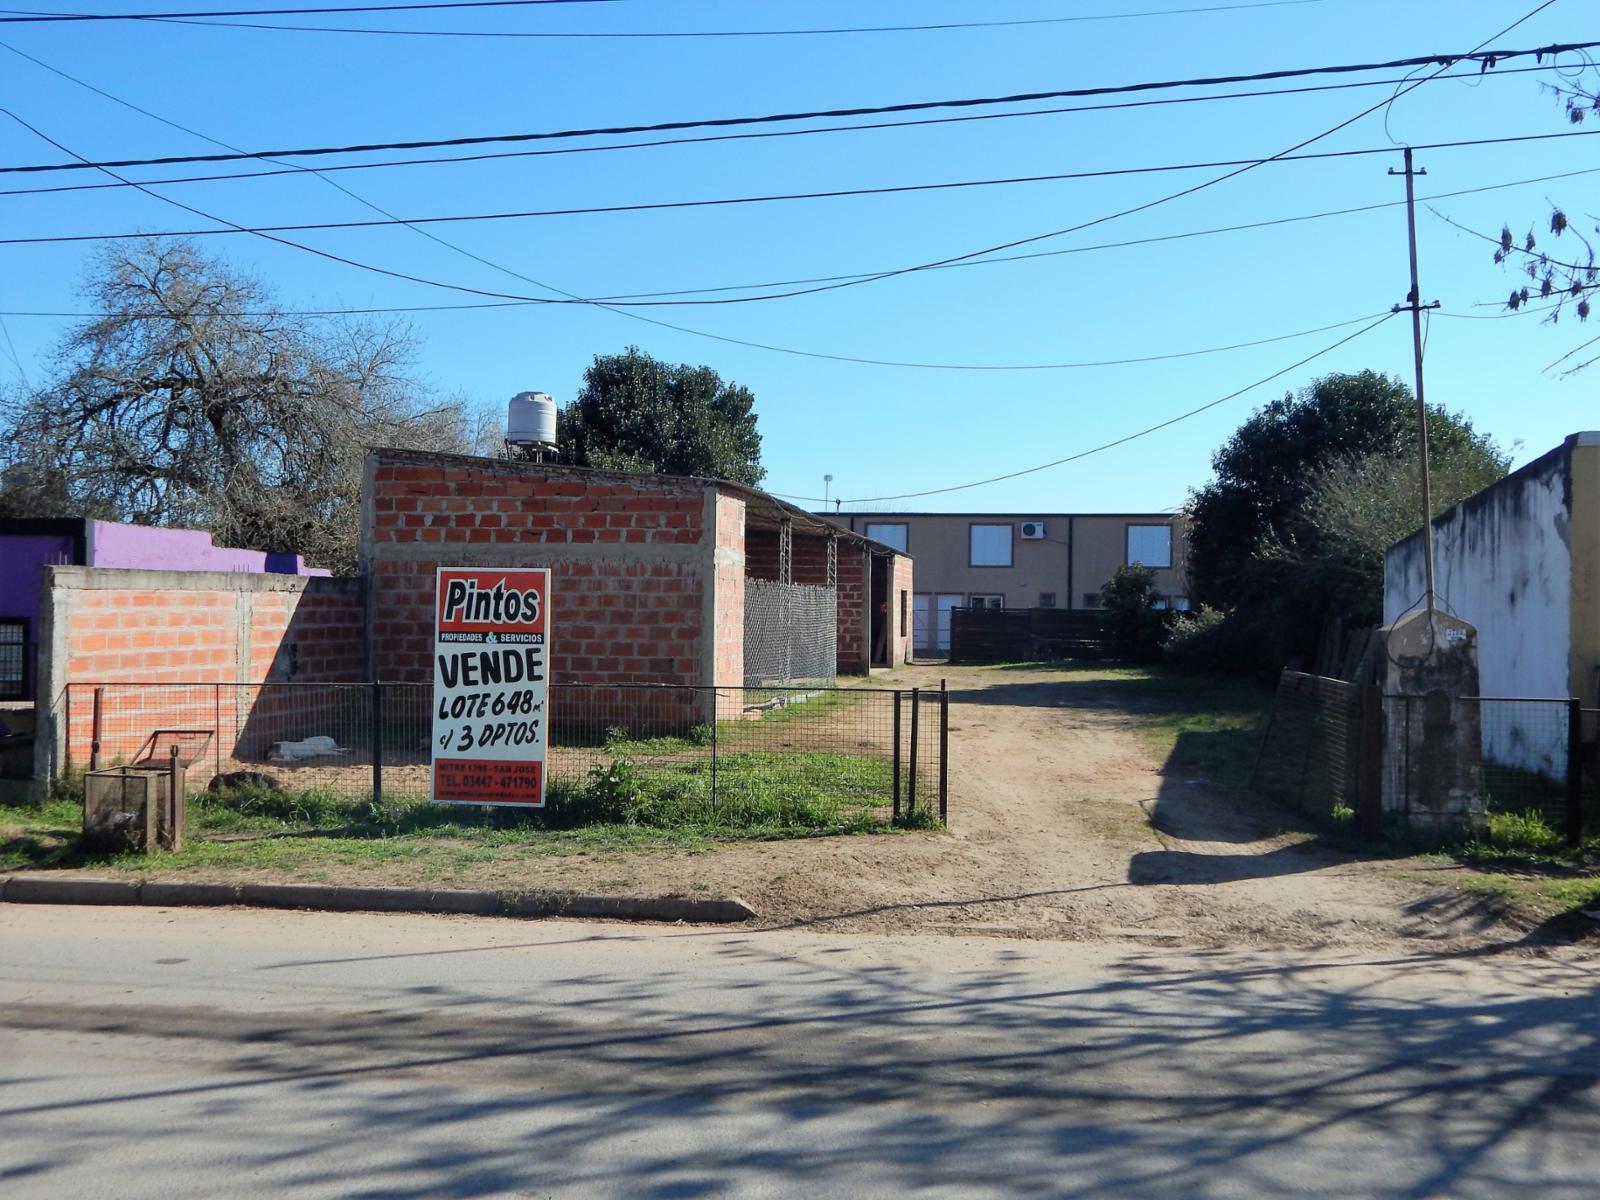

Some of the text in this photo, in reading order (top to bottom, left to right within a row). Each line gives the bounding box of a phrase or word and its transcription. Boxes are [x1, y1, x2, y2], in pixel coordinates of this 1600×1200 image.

[443, 577, 541, 624] Pintos
[441, 632, 542, 644] PROPIEDADES & SERVICIOS
[438, 648, 543, 688] VENDE
[439, 693, 491, 719] LOTE
[457, 725, 474, 752] 3
[478, 720, 540, 747] DPTOS.
[463, 775, 493, 788] 03447
[500, 776, 537, 789] 471790
[494, 766, 512, 774] SAN
